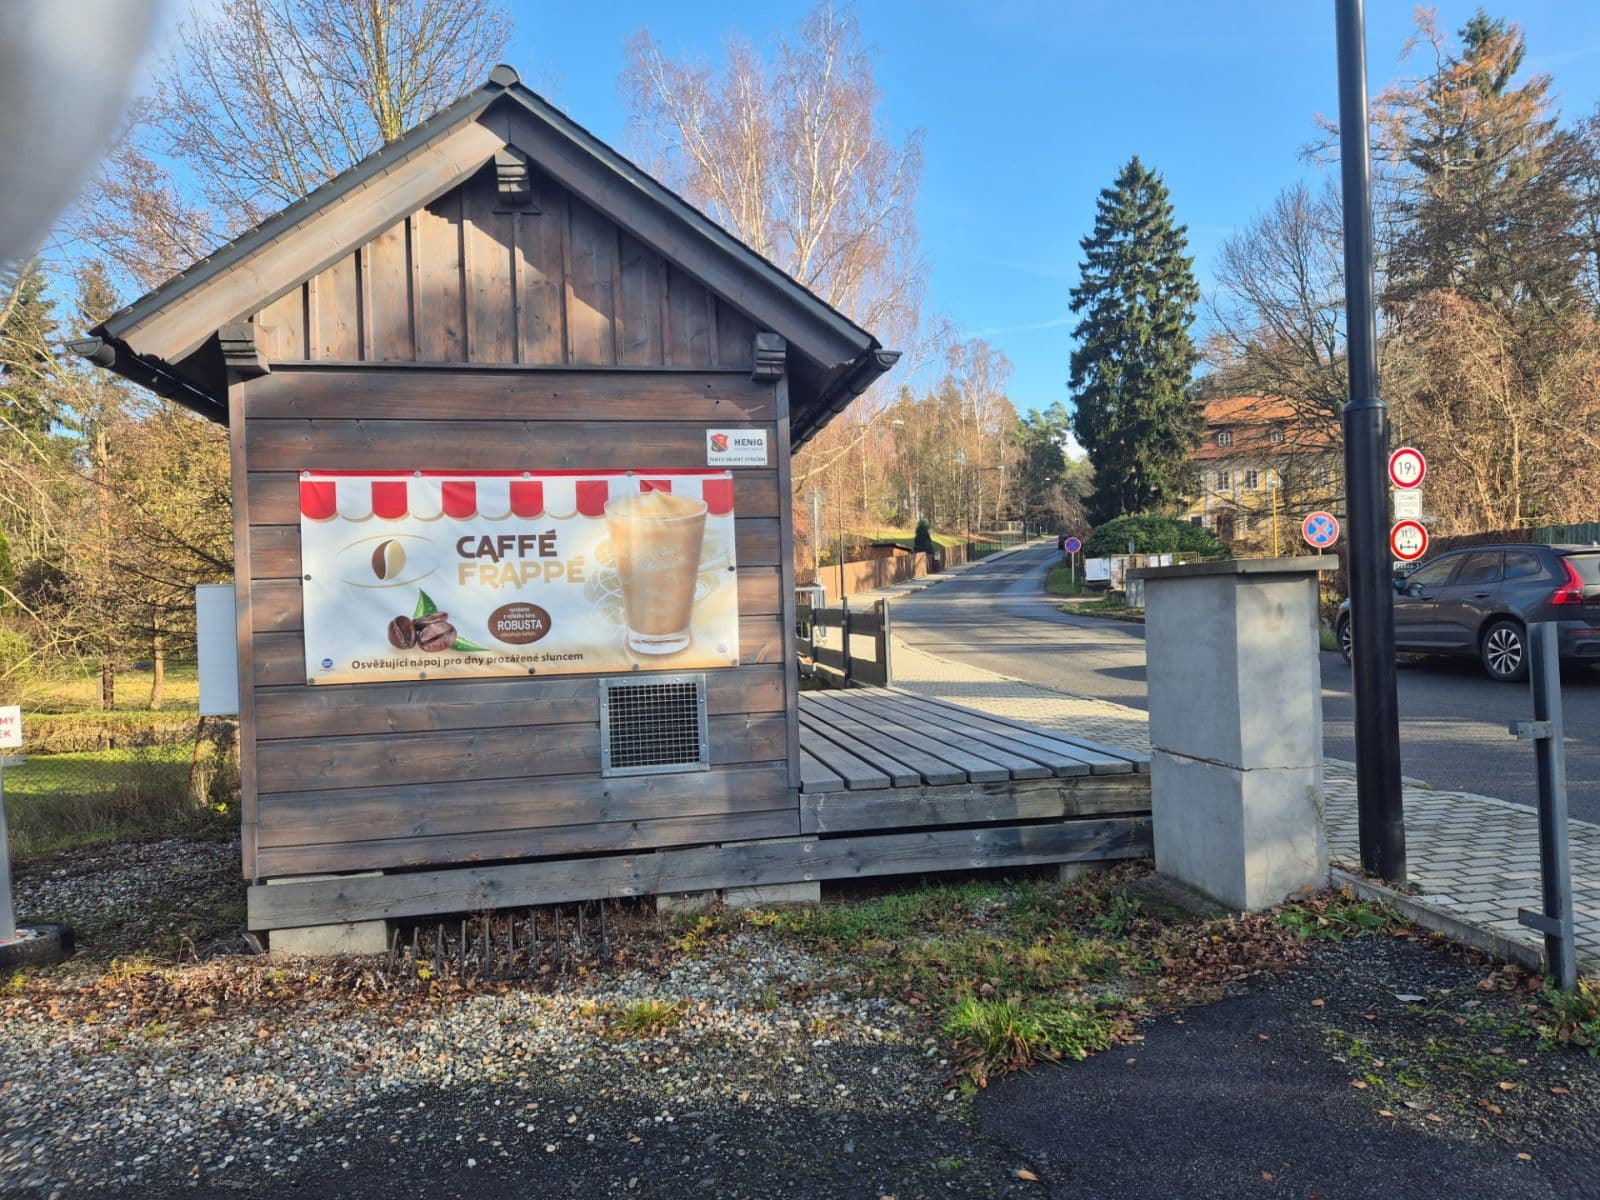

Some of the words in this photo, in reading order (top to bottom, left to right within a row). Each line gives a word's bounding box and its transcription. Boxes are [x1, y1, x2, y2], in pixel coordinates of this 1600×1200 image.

[734, 438, 764, 446] HENIG
[456, 529, 558, 563] CAFFÉ
[457, 555, 586, 589] FRAPPÉ
[497, 619, 543, 631] ROBUSTA
[351, 658, 408, 670] Osvěžující
[410, 657, 441, 670] nápoj
[443, 657, 462, 667] pro
[464, 655, 483, 666] dny
[486, 653, 539, 666] prozářené
[541, 652, 584, 662] sluncem
